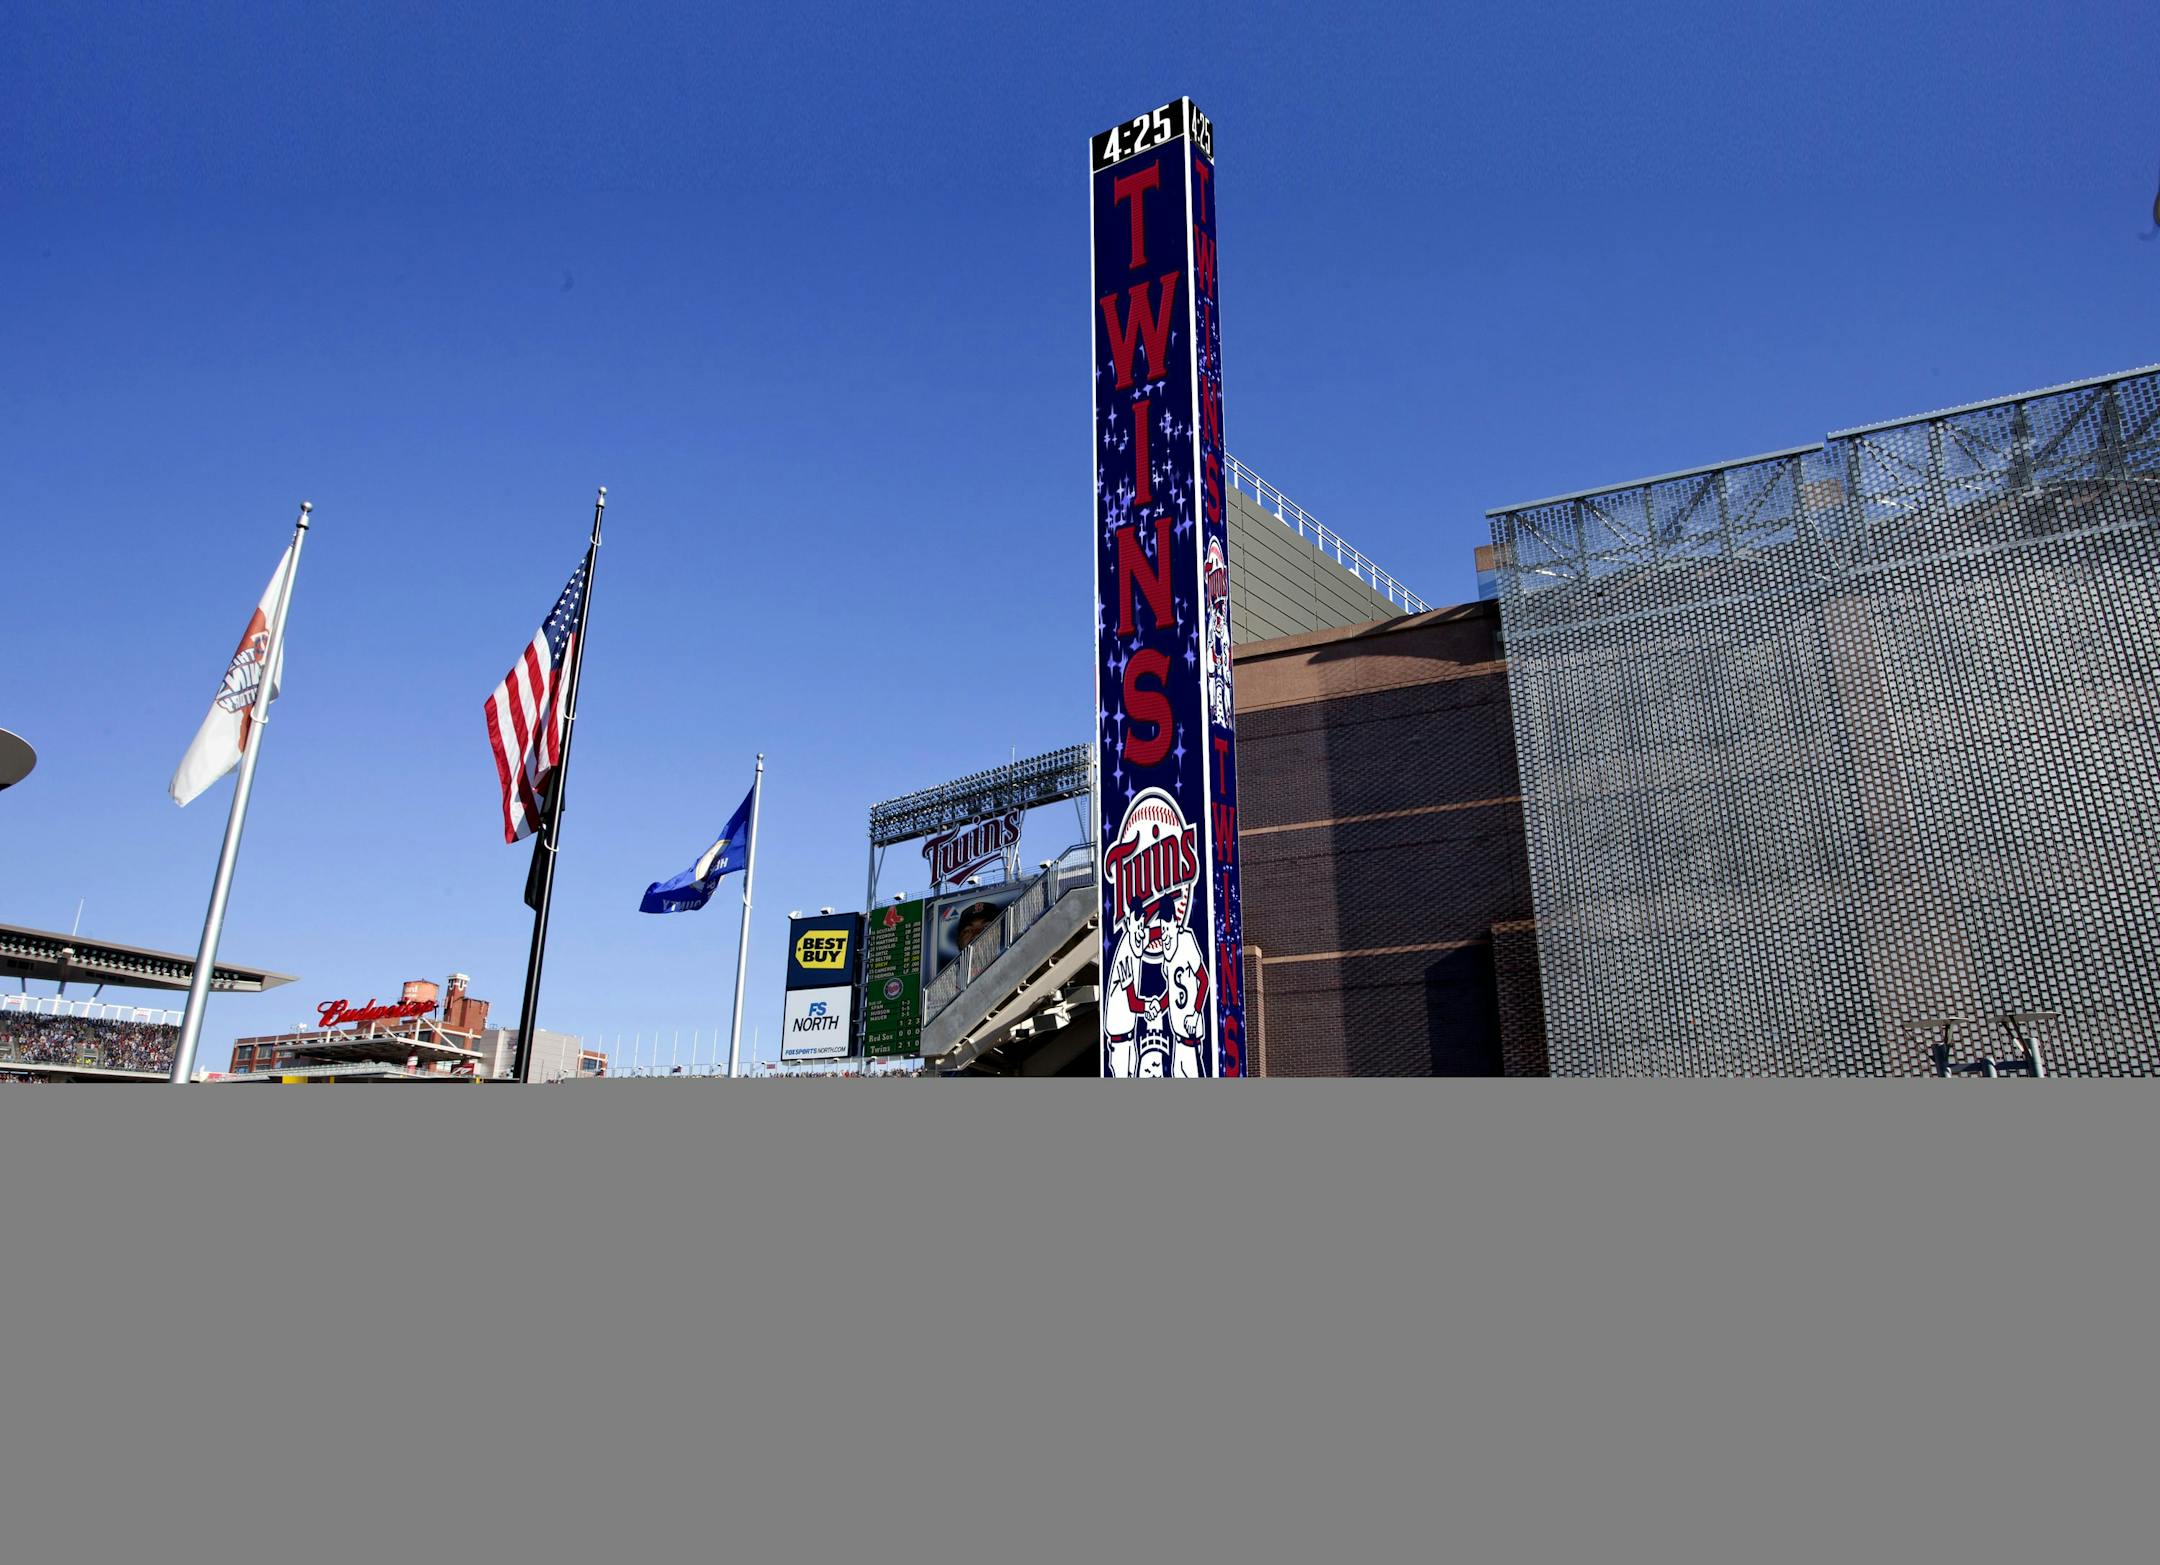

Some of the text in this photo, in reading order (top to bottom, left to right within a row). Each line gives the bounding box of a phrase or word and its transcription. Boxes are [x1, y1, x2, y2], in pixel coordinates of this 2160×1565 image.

[1103, 103, 1172, 162] 4:25
[1191, 105, 1211, 155] 4:25
[1100, 159, 1180, 767] TWINS
[922, 808, 1021, 888] Twins
[1105, 826, 1197, 925] Twins
[802, 951, 841, 962] BUY
[803, 938, 846, 950] BEST
[317, 997, 437, 1027] Budweiser
[793, 1016, 839, 1032] NORTH
[809, 1002, 827, 1016] FS
